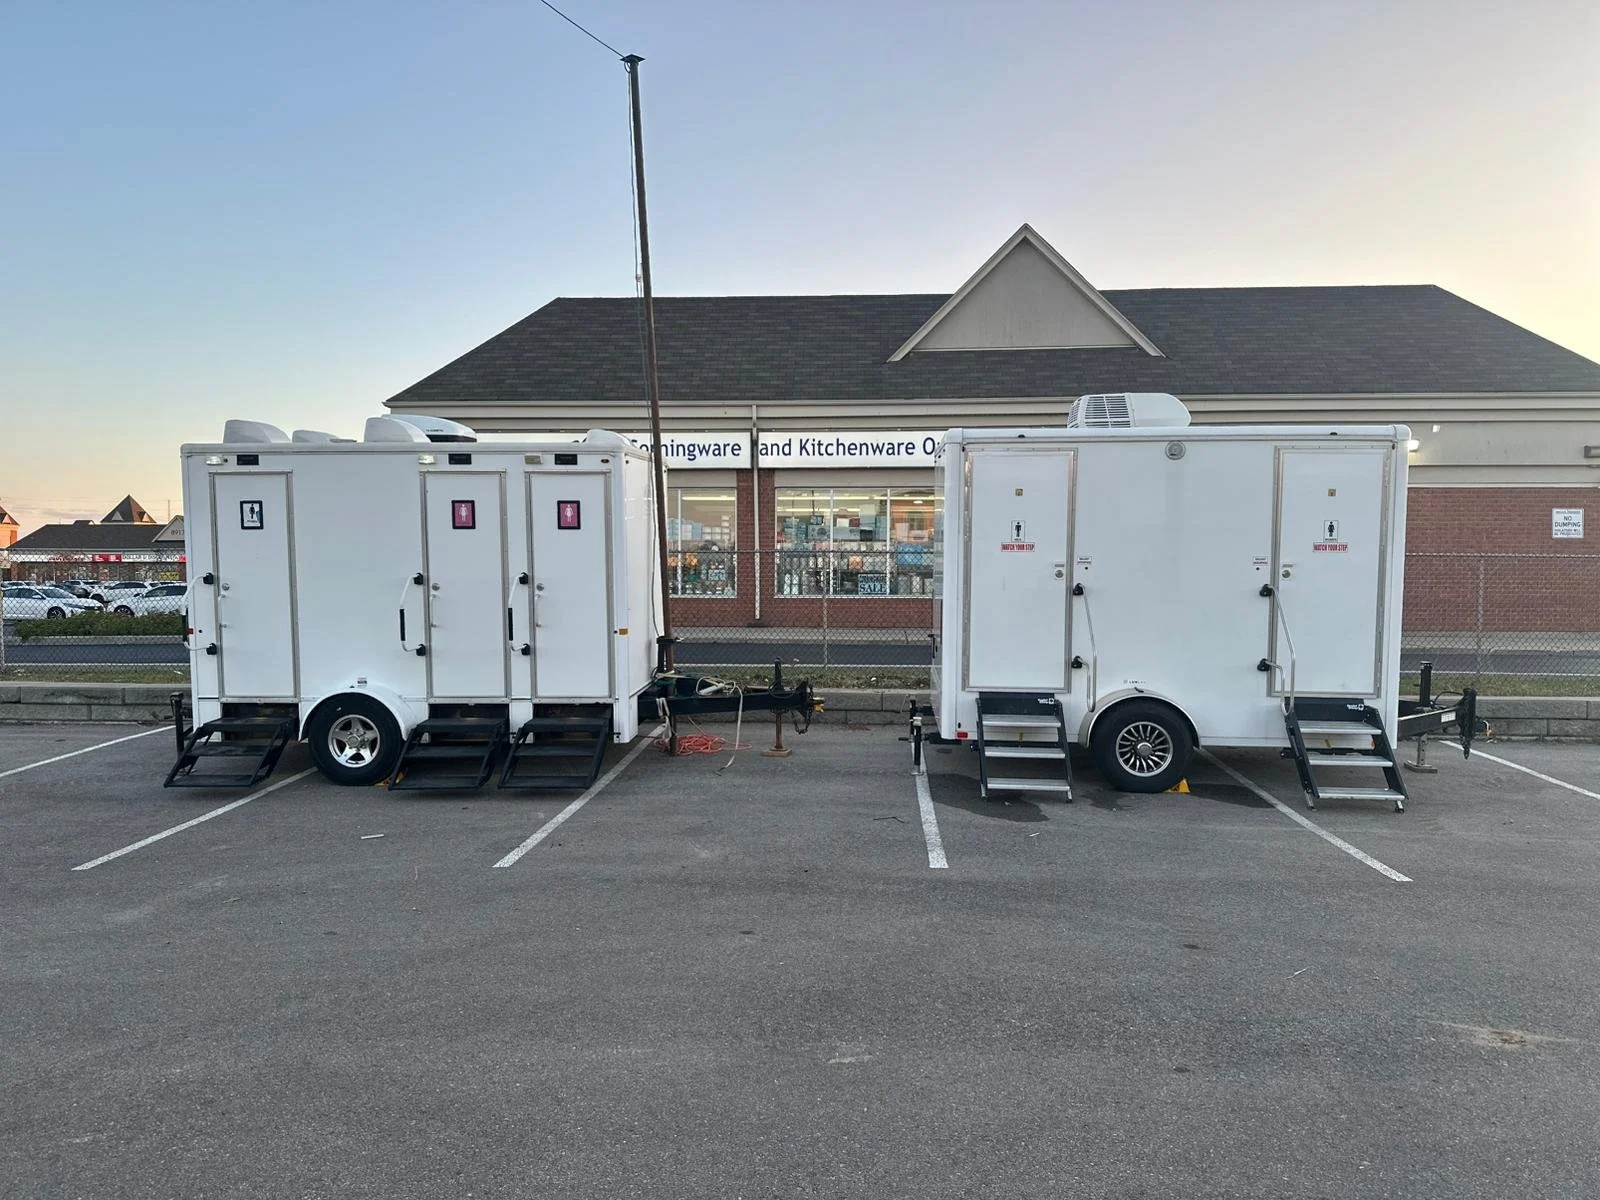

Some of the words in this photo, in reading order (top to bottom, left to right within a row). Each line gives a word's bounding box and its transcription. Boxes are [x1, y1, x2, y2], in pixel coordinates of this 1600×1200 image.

[759, 438, 792, 456] and
[799, 434, 916, 456] Kitchenware
[1338, 543, 1347, 551] STEP
